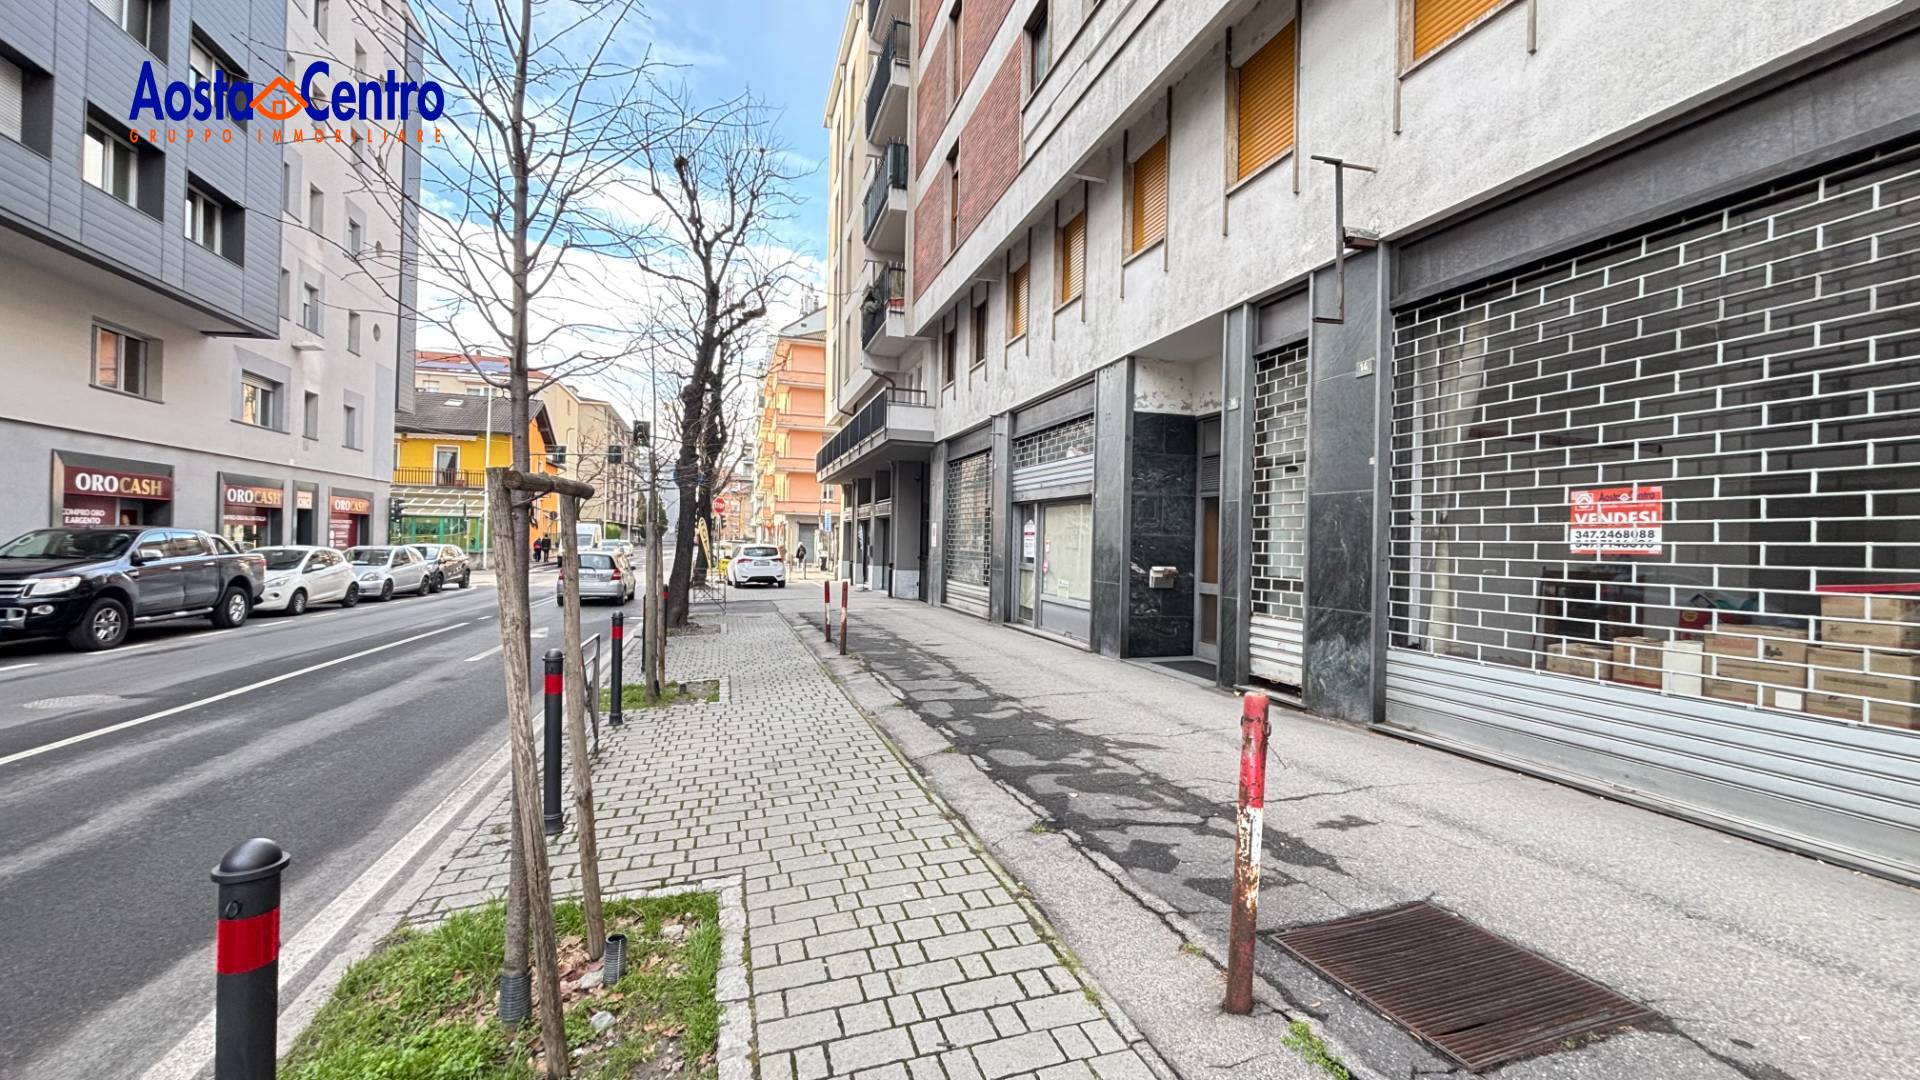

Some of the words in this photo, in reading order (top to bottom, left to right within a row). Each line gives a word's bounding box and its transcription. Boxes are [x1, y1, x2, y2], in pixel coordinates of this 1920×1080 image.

[75, 472, 163, 496] OROCASH
[1574, 510, 1658, 525] VENDESI
[1575, 530, 1655, 539] 347.2468088
